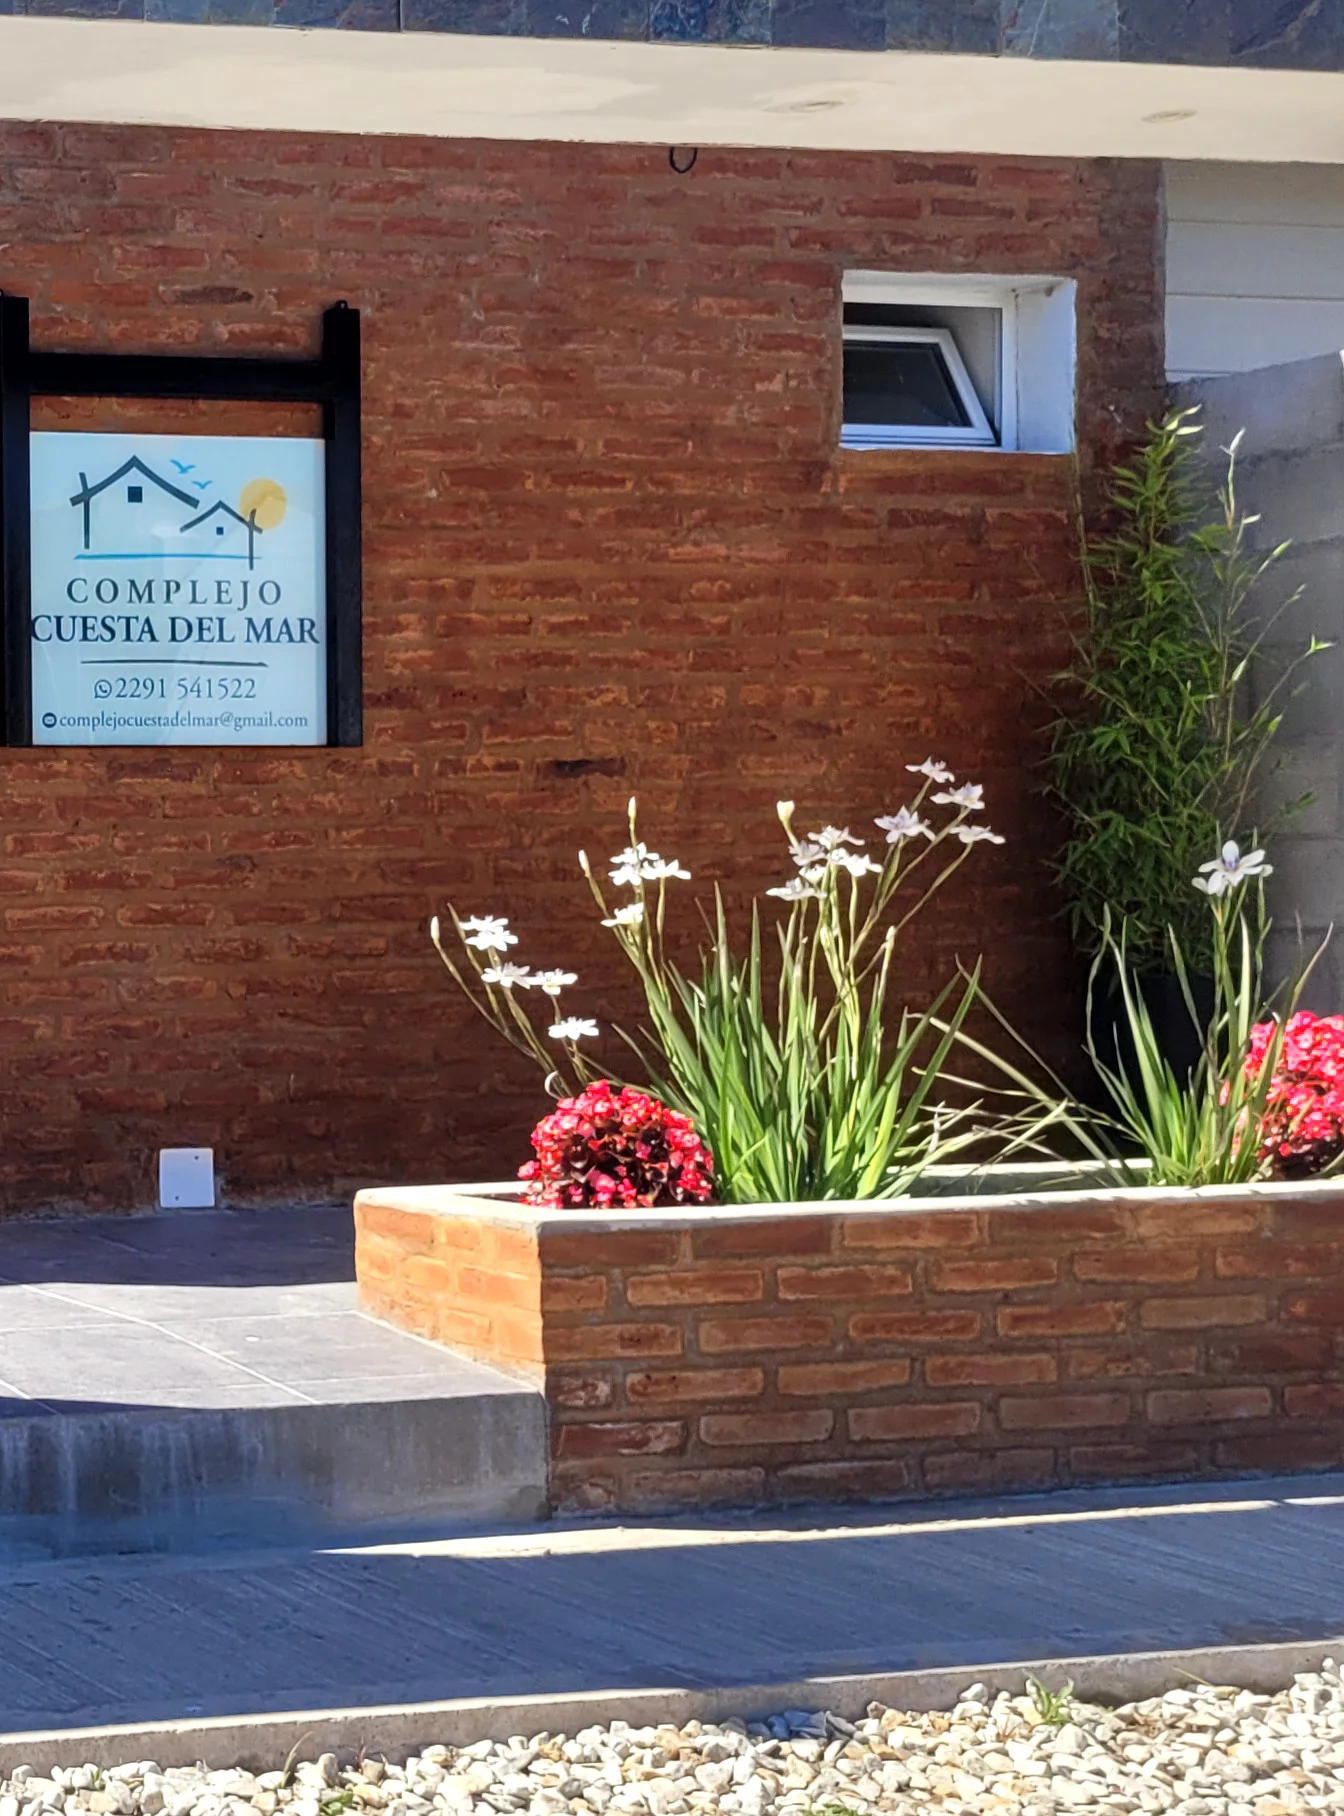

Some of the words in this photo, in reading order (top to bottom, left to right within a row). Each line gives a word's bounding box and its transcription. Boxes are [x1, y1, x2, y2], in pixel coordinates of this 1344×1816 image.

[66, 577, 282, 611] COMPLEJO
[30, 614, 159, 644] CUESTA
[168, 616, 235, 644] DEL
[243, 616, 320, 645] MAR
[115, 677, 167, 700] 2291
[177, 674, 257, 700] 541522
[59, 710, 308, 732] complejocuestadelmar@gmail.com
